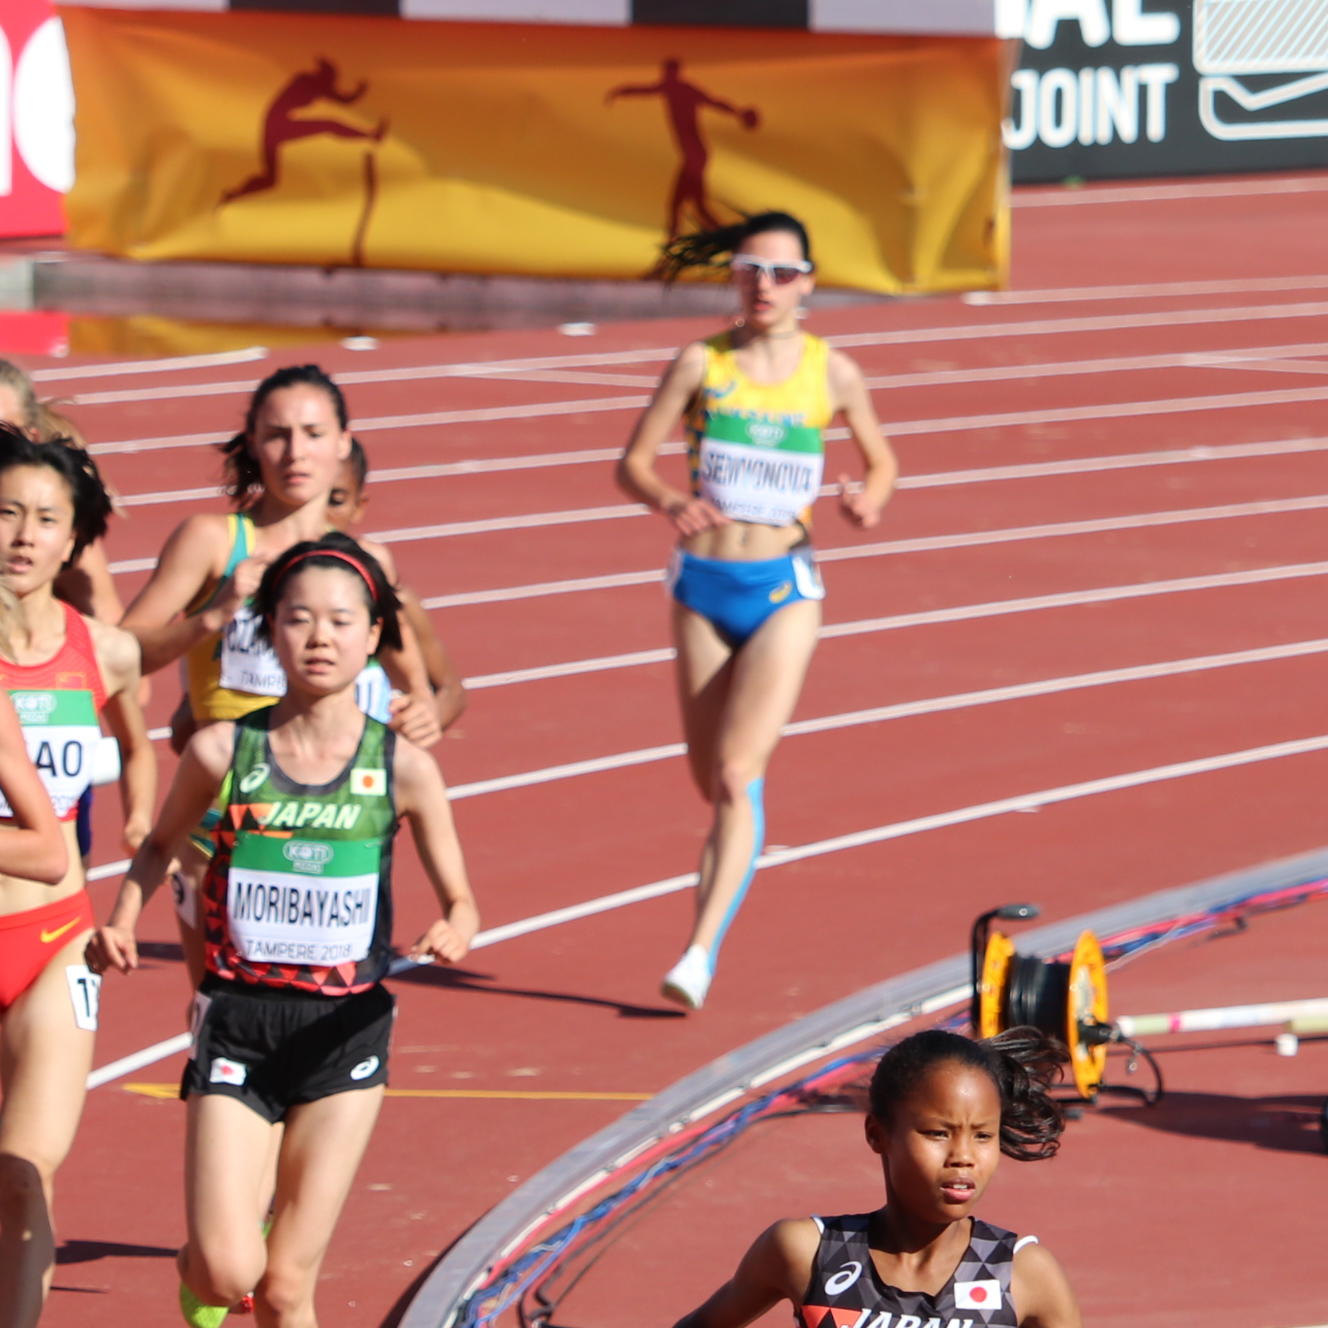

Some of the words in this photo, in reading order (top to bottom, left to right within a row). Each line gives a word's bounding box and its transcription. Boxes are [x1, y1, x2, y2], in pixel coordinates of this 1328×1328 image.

[35, 740, 83, 778] AO
[257, 801, 362, 829] JAPAN
[233, 881, 371, 927] MORIBAYASHI
